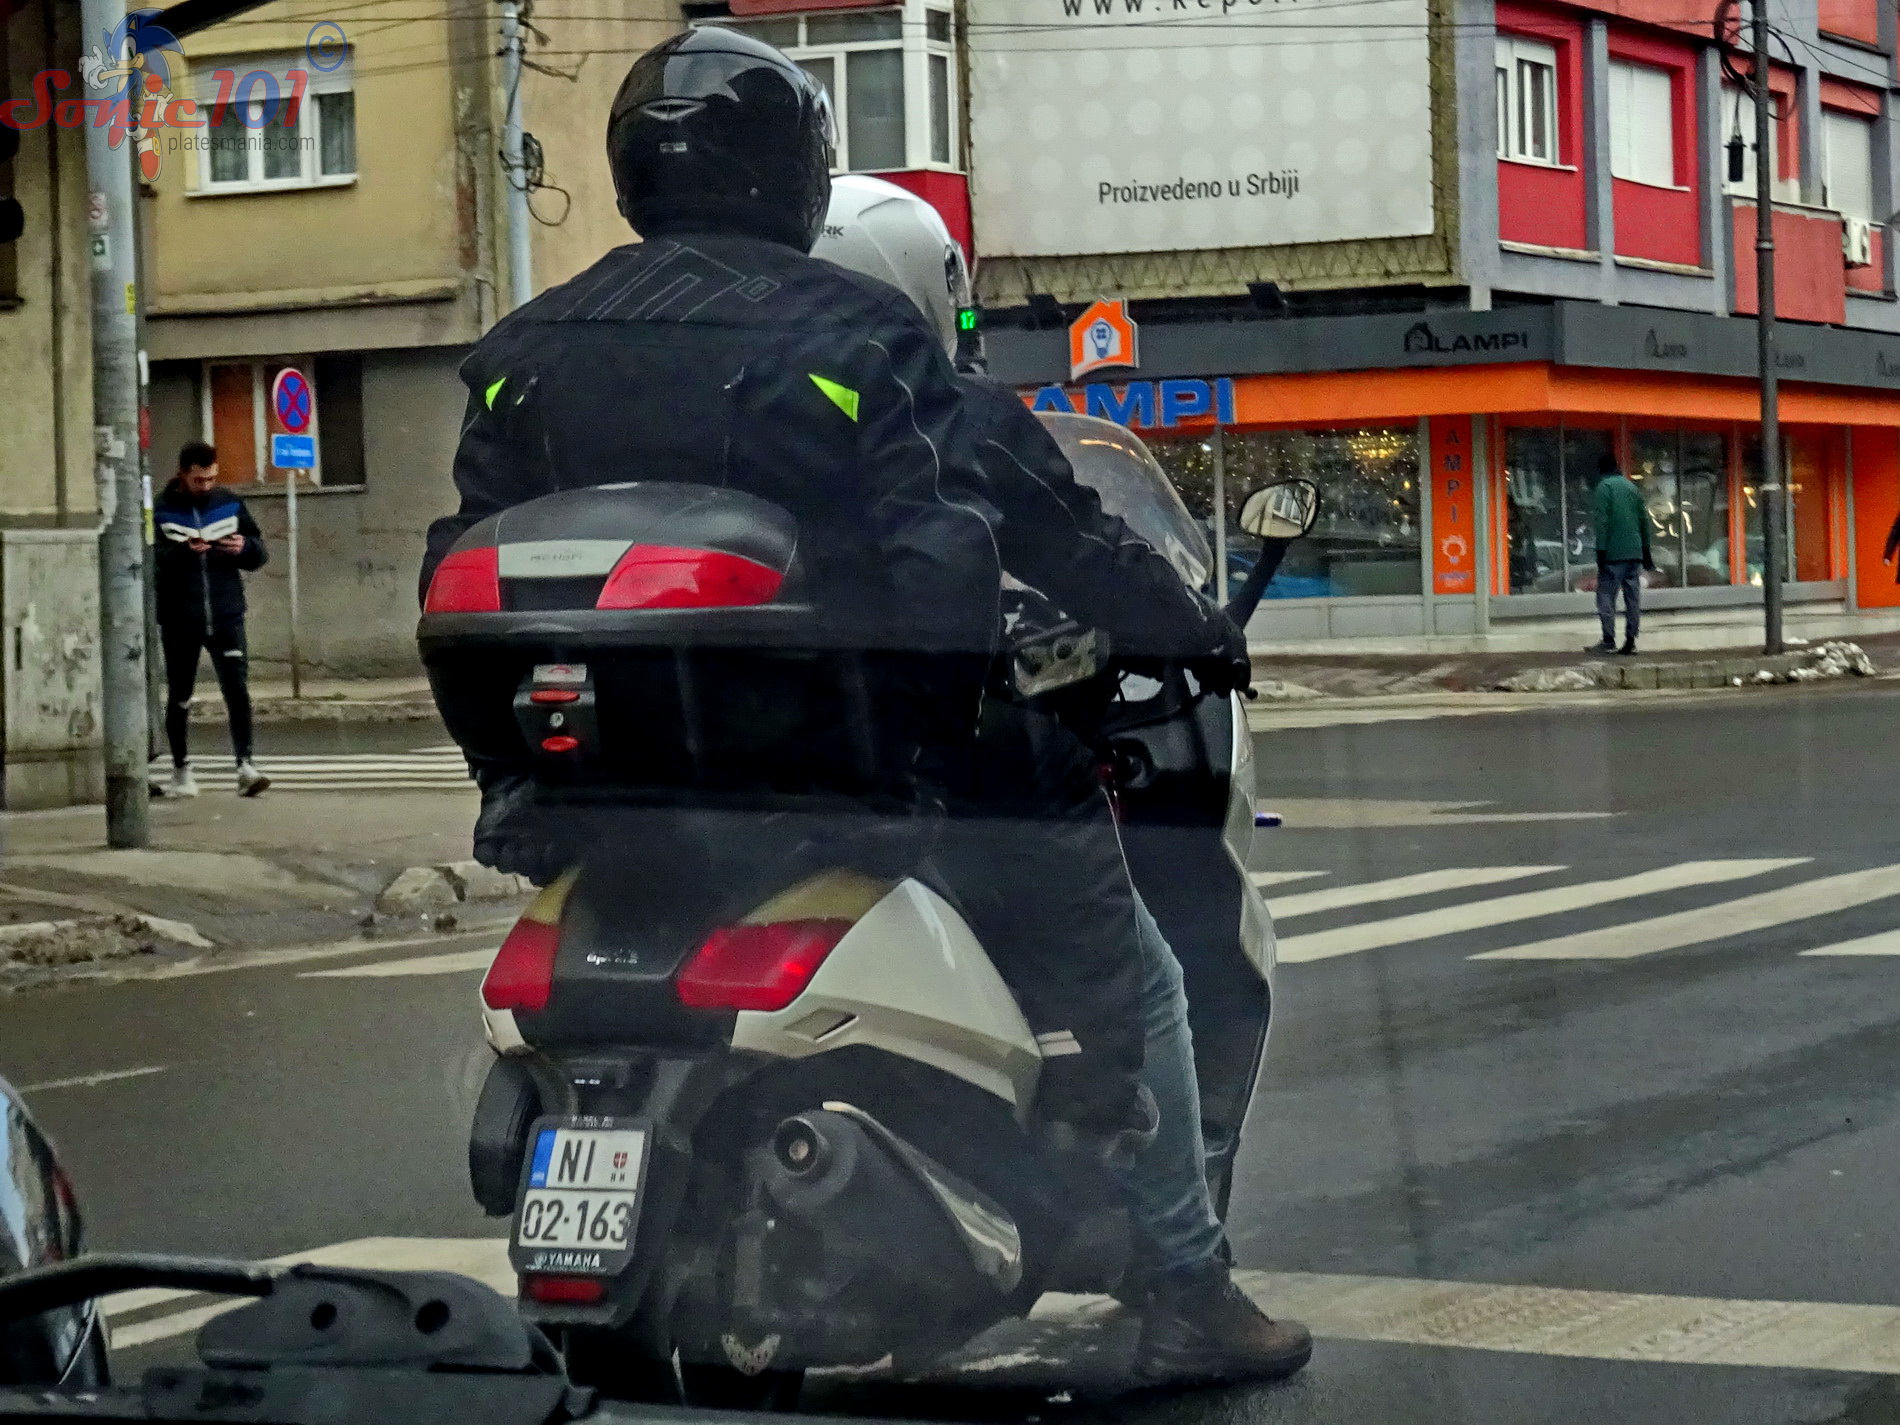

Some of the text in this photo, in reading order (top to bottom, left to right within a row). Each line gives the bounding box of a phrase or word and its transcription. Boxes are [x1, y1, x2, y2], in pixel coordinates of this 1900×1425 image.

[1099, 169, 1299, 204] Proizvedeno u Srbiji
[1434, 331, 1528, 353] LAMPI
[557, 1139, 596, 1183] NI
[549, 1252, 600, 1268] YAMAHA
